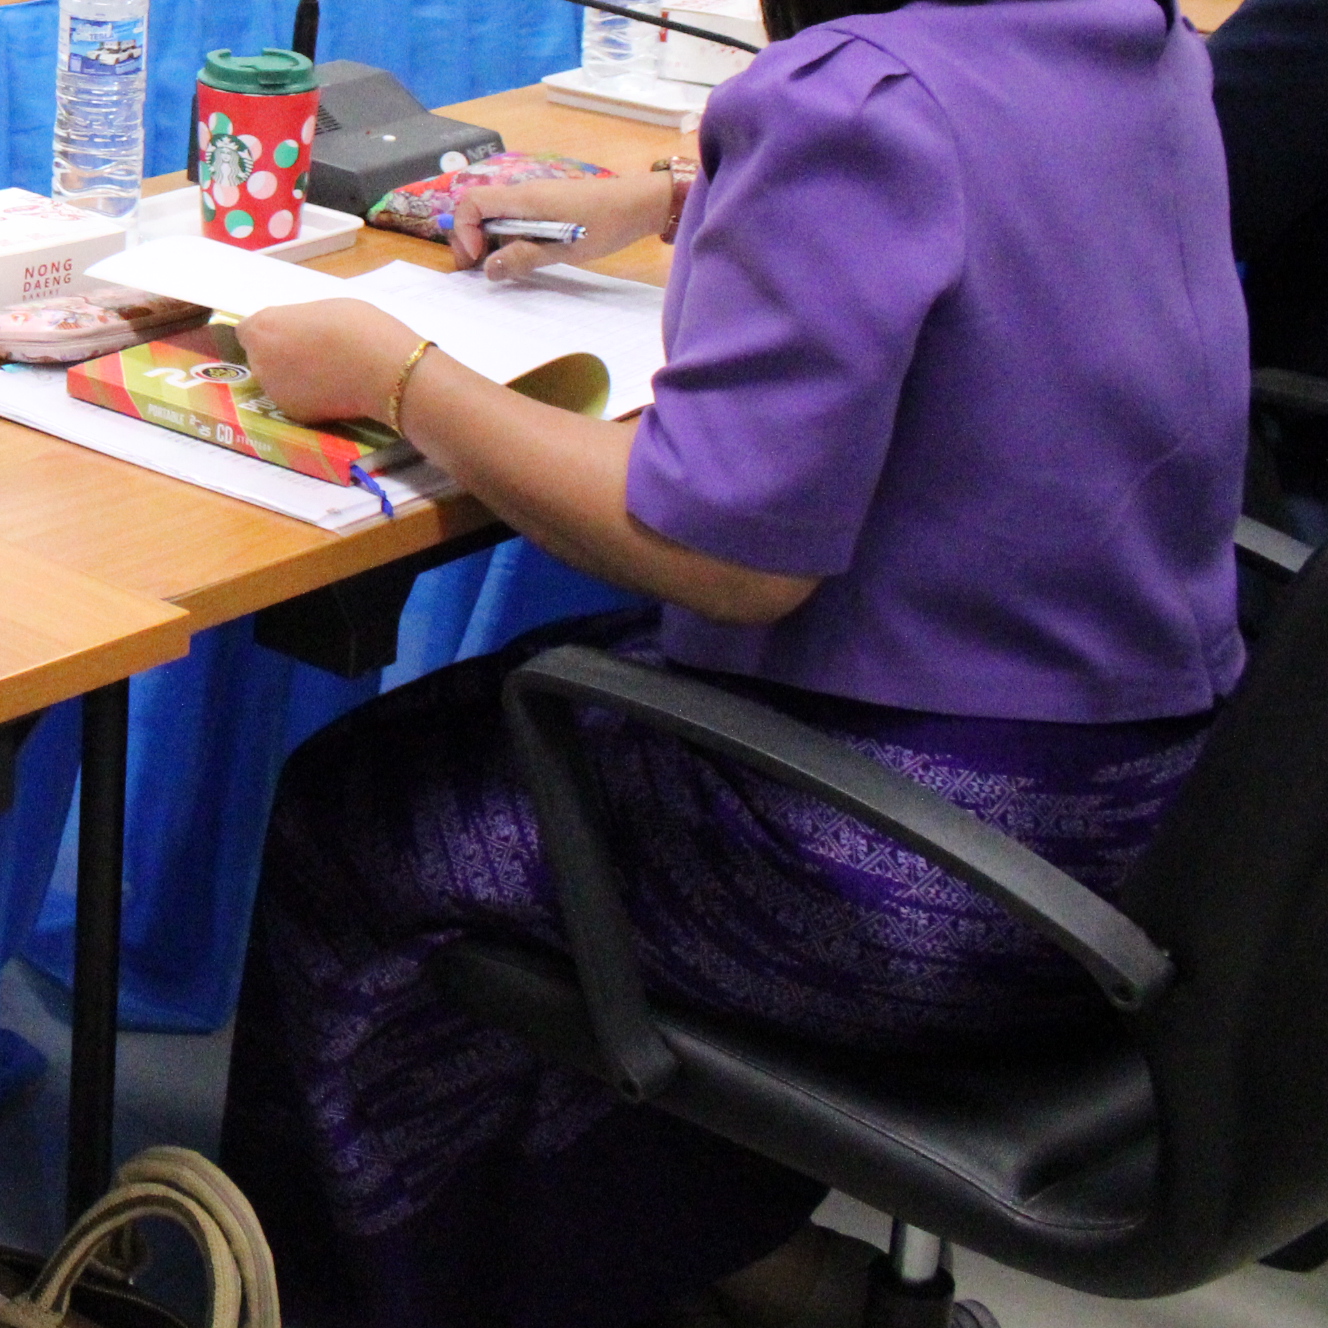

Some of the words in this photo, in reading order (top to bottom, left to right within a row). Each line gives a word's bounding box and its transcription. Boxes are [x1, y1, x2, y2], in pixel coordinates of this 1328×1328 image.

[466, 142, 501, 162] NPE
[24, 258, 73, 280] NONG
[23, 273, 71, 293] DAENG
[216, 423, 234, 445] CD
